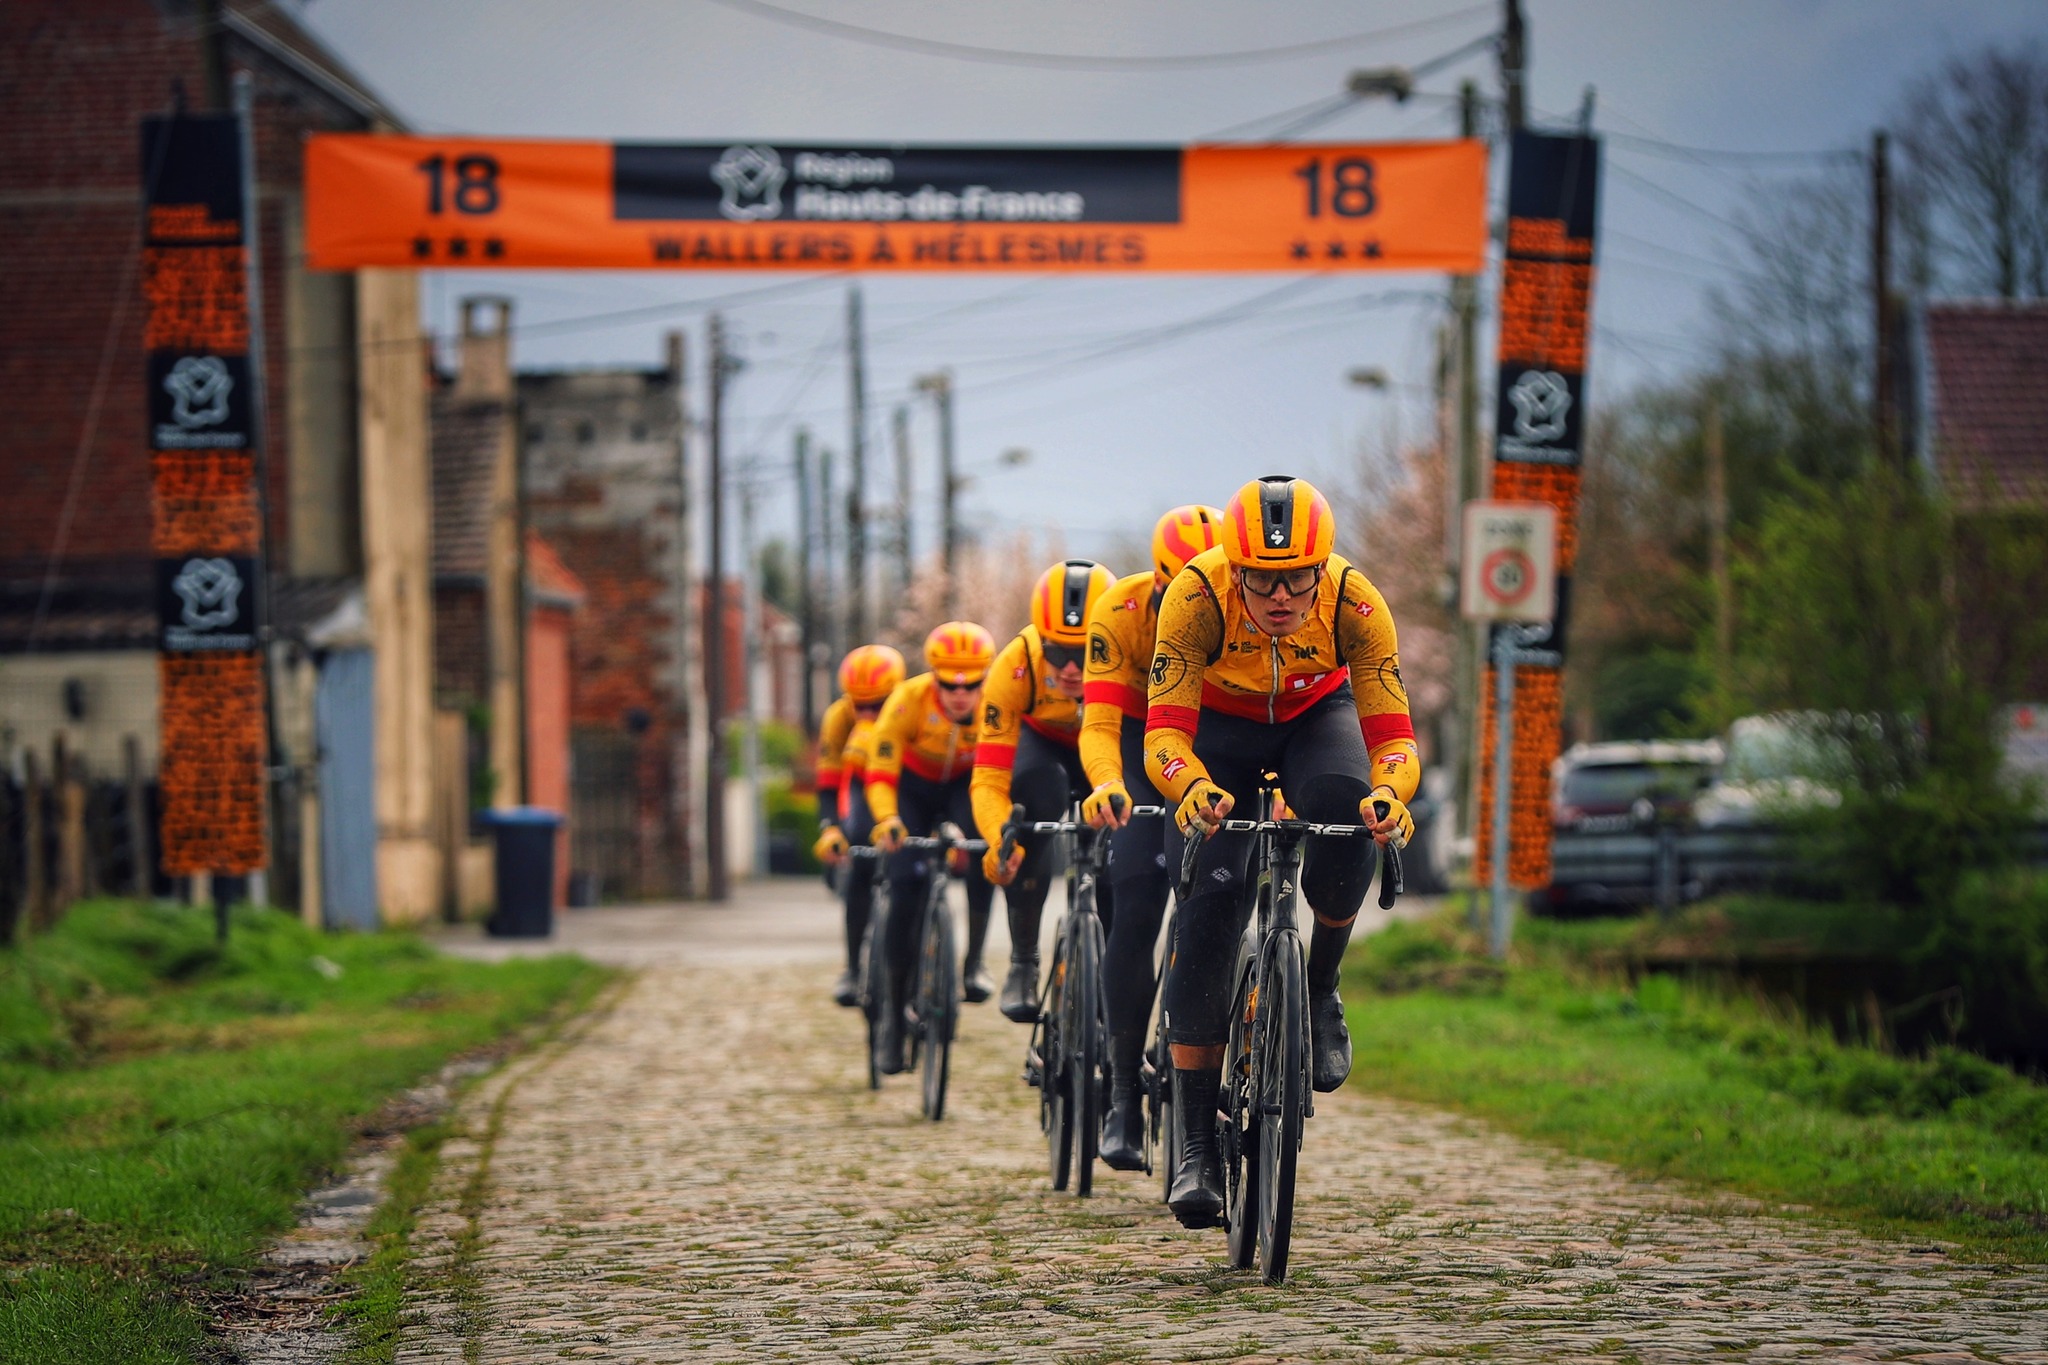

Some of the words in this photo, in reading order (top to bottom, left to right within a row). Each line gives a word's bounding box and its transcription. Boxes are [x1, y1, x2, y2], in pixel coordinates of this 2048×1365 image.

[417, 152, 501, 216] 18
[795, 153, 894, 187] Région
[1294, 156, 1378, 219] 18
[651, 232, 854, 262] WALLERS
[1091, 633, 1111, 664] R
[1147, 653, 1170, 686] R
[1156, 747, 1170, 765] Uno
